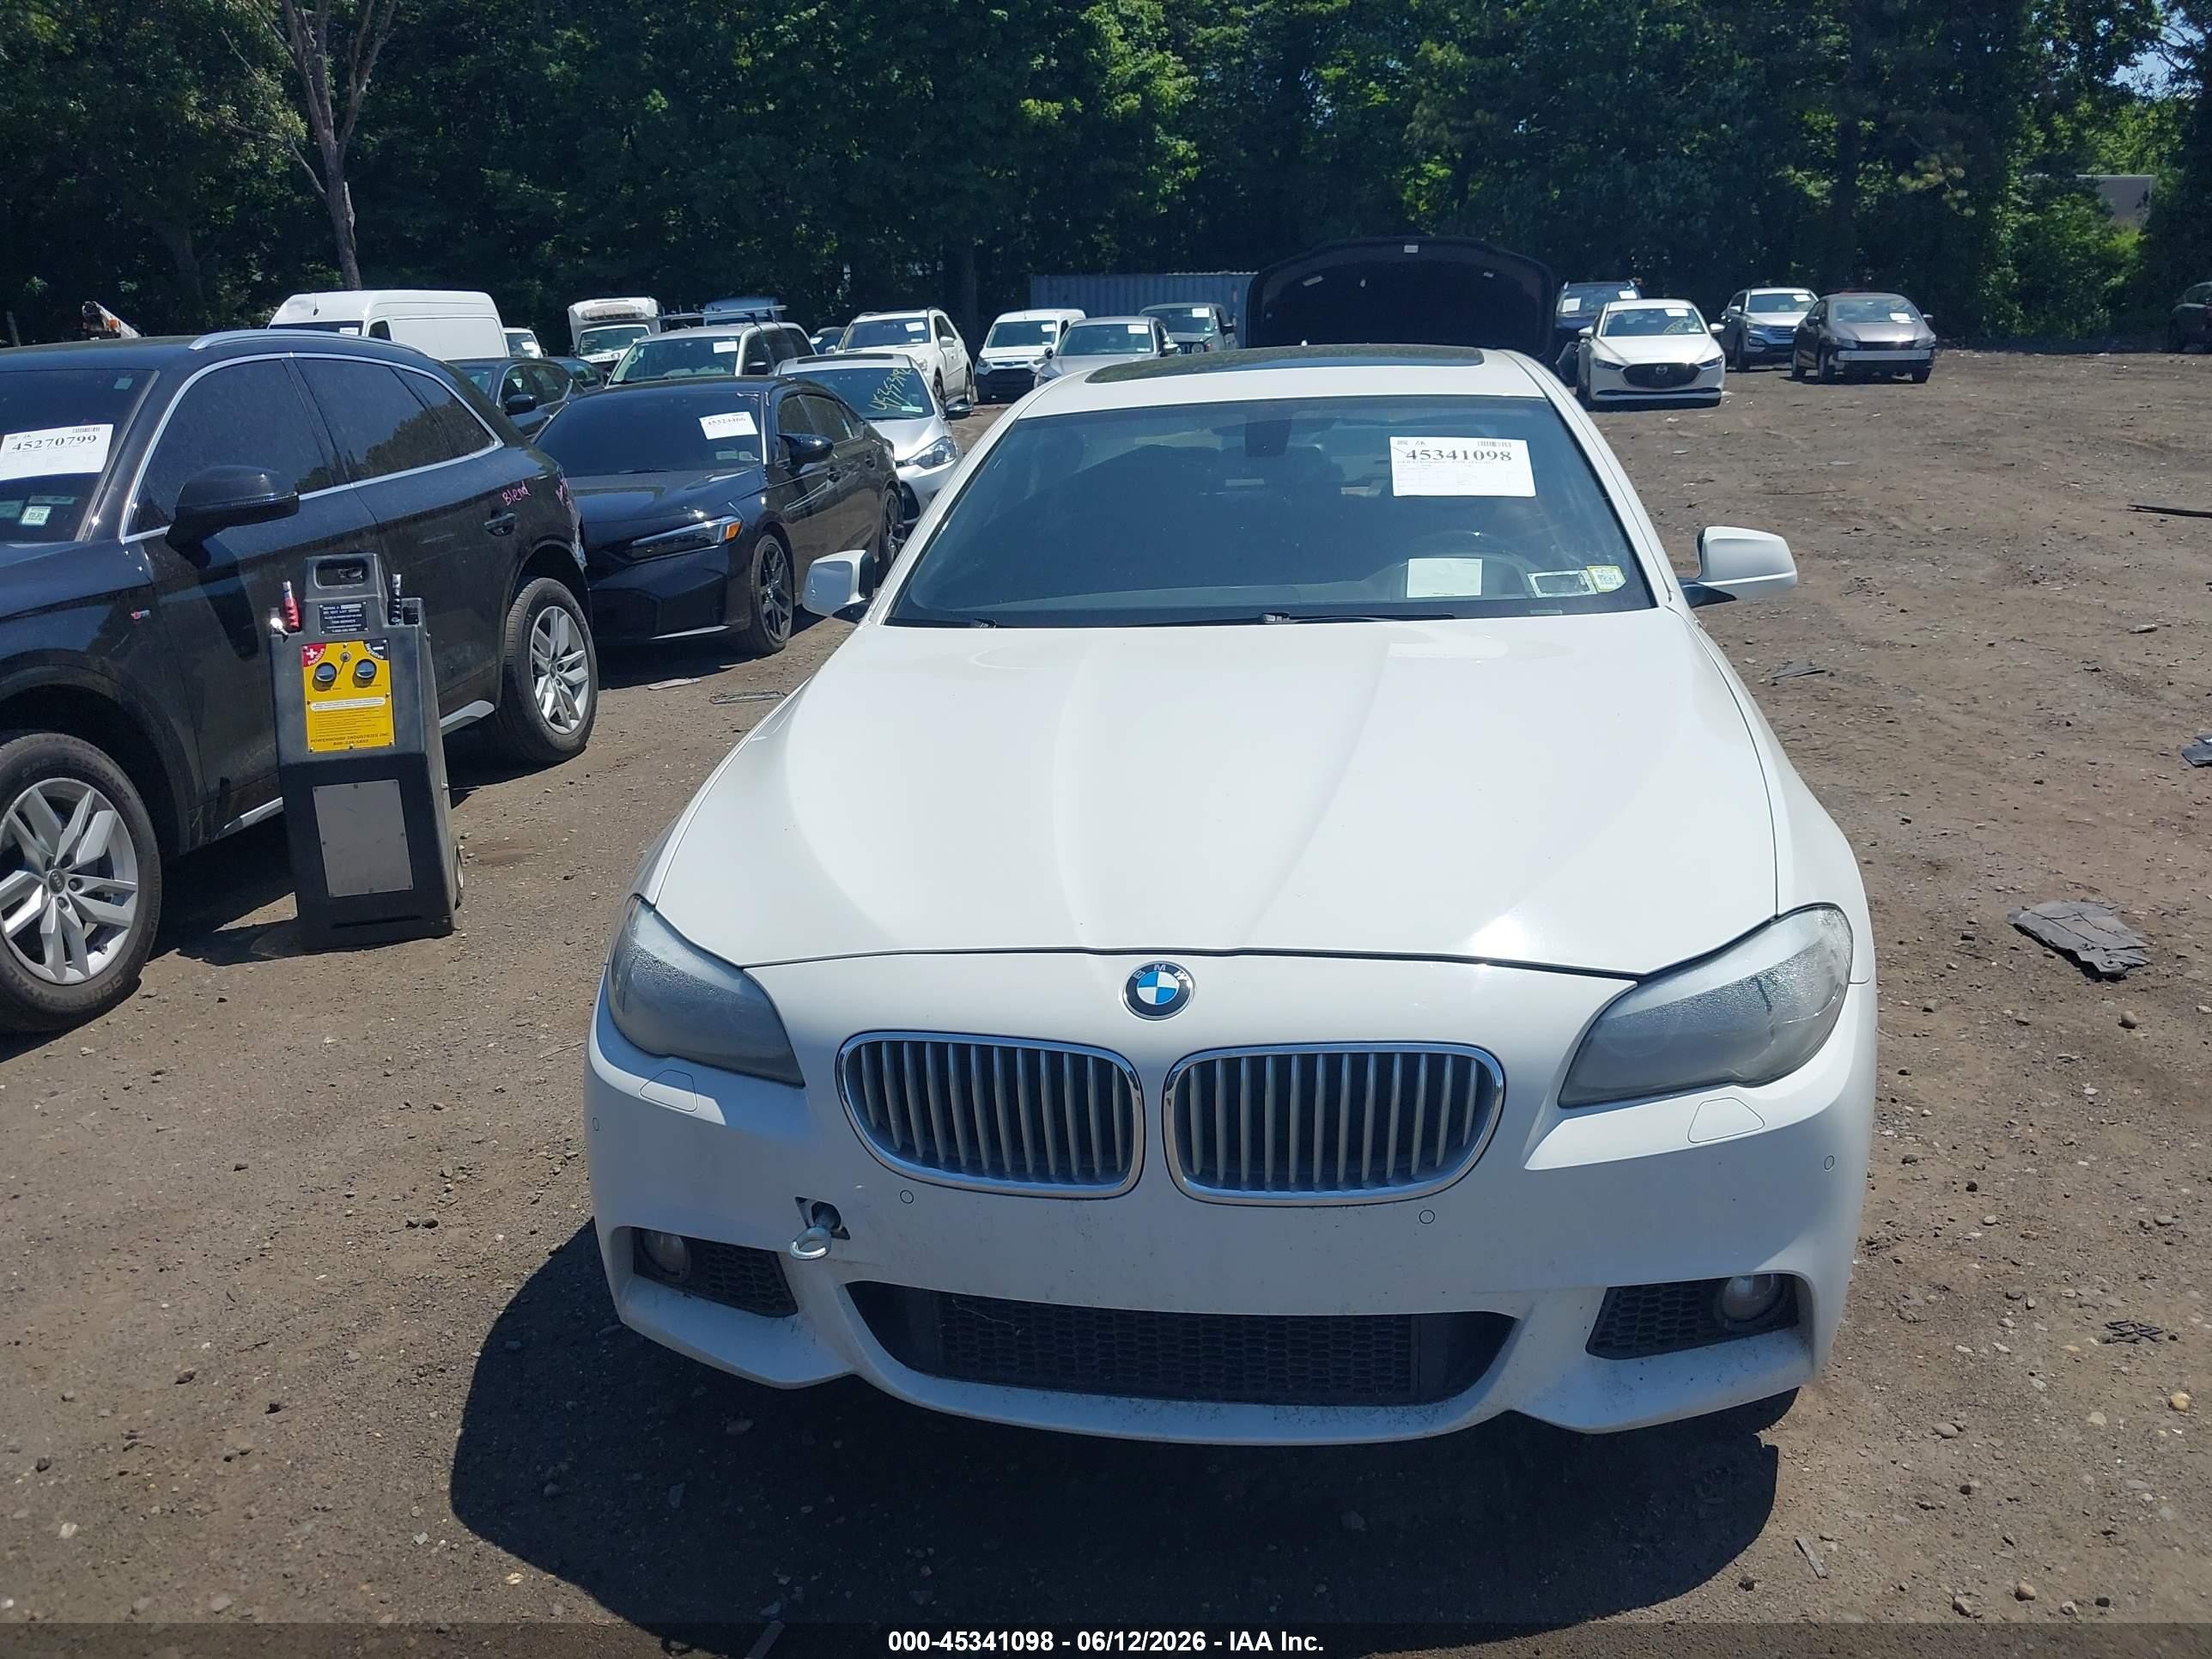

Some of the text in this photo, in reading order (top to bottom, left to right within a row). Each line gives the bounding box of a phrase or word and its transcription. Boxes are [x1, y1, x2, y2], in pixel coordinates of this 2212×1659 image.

[11, 434, 97, 451] 45270799
[1406, 449, 1512, 461] 45341098
[501, 480, 532, 507] Blend
[307, 647, 325, 665] Positive
[365, 643, 385, 660] Negative
[1133, 963, 1189, 981] BMW
